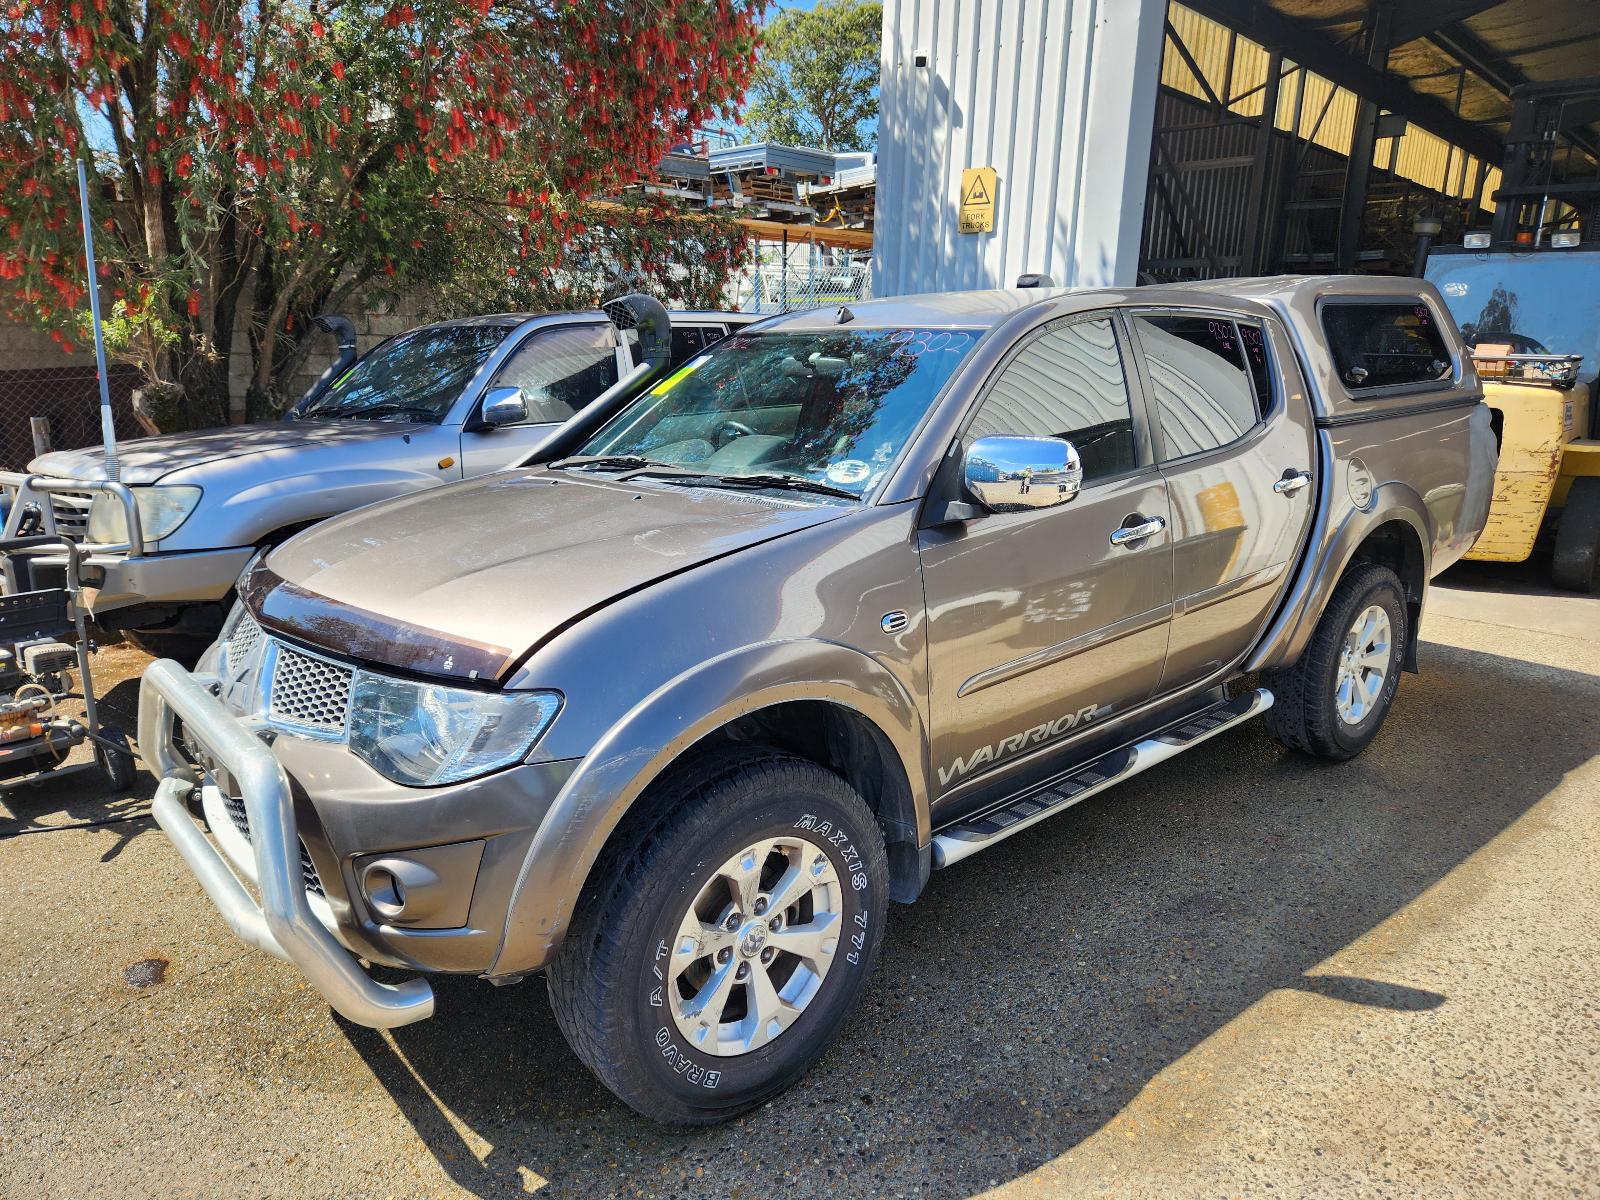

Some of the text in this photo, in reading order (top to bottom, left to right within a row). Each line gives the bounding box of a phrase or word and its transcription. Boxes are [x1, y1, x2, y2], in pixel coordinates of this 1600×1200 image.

[961, 222, 990, 230] TRUCKS
[966, 213, 985, 221] FORK
[890, 330, 970, 357] 9302
[1208, 321, 1236, 340] 9302
[937, 703, 1098, 786] WARRIOR
[793, 814, 868, 965] MAXXIS 771
[650, 939, 722, 1089] BRAVO A/T
